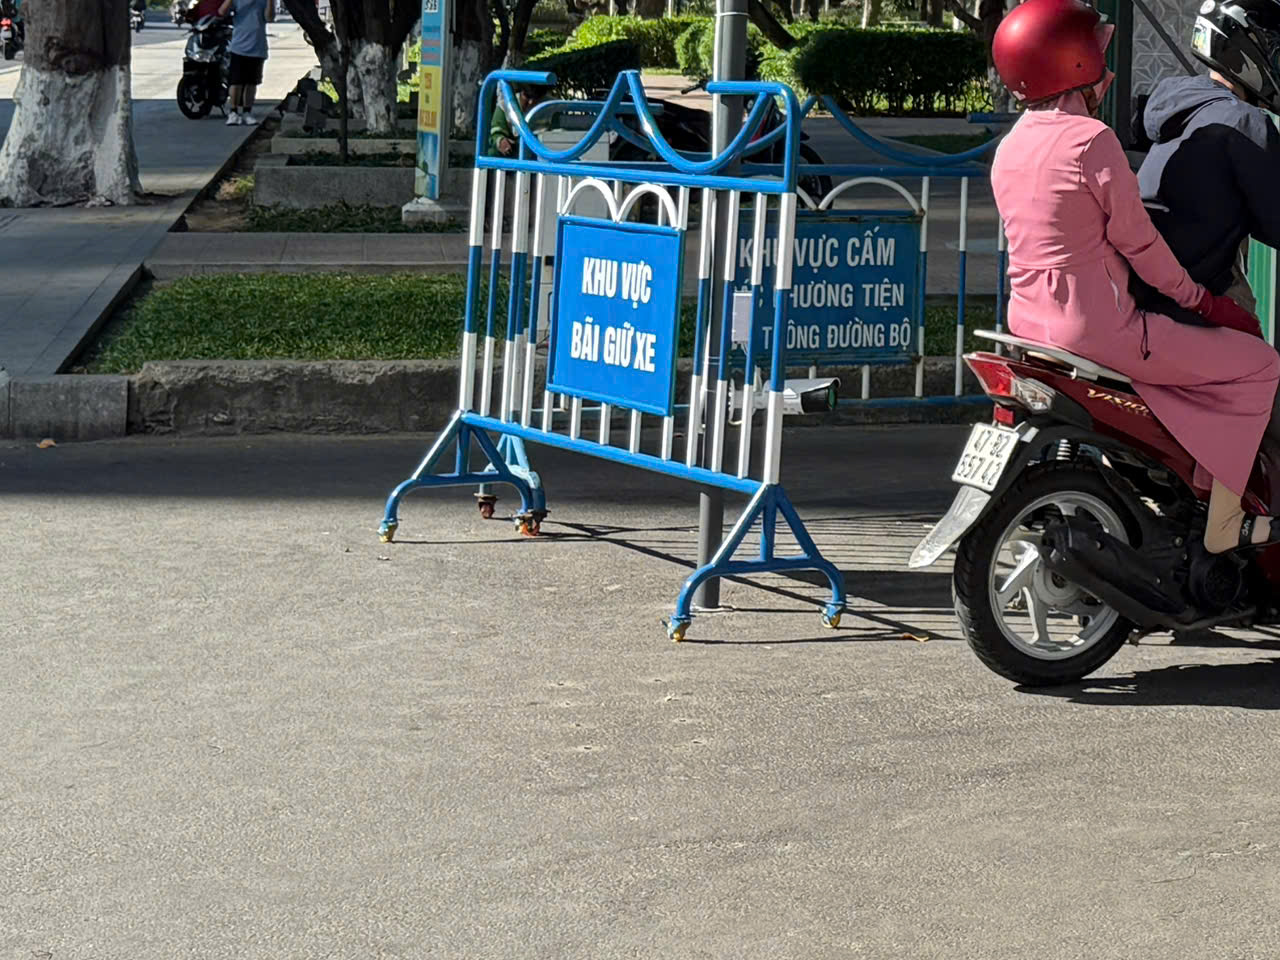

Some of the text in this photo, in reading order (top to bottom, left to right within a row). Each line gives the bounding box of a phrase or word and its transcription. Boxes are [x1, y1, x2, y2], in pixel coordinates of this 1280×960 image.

[793, 234, 839, 273] VỰC
[846, 226, 895, 268] CẤM
[582, 256, 653, 309] KHU VỰC
[862, 278, 904, 311] TIỆN
[571, 315, 657, 373] BÃI GIỮ XE
[827, 317, 885, 349] ĐƯỜNG
[889, 317, 911, 351] BỘ
